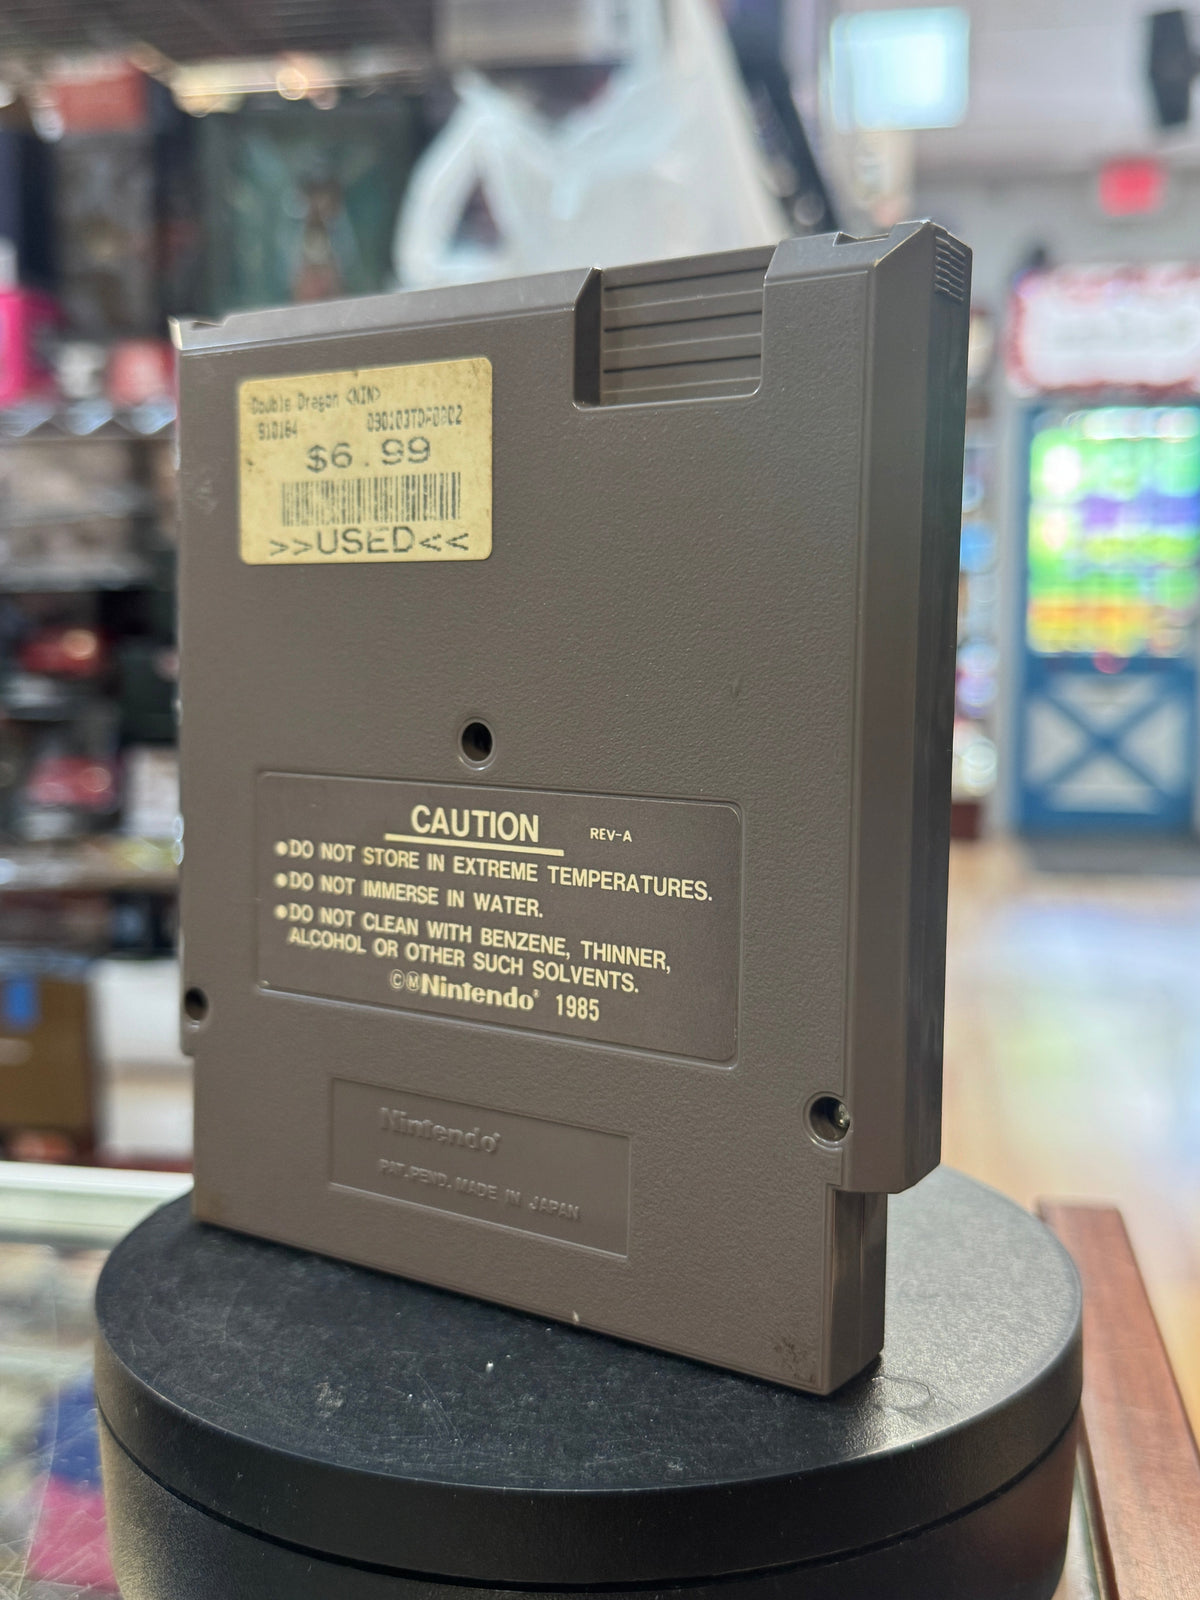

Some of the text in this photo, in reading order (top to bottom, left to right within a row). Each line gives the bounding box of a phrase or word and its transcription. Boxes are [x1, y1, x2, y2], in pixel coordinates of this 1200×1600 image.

[251, 394, 291, 415] Double
[297, 392, 339, 413] Dragon
[306, 436, 431, 473] $6.99
[411, 804, 539, 843] CAUTION
[590, 827, 632, 843] REV-A
[288, 838, 713, 902] DO NOT STORE IN EXTREME TEMPERATURES.
[288, 870, 543, 918] DO NOT IMMERSE IN WATER.
[288, 902, 671, 974] DO NOT CLEAN WITH BENZENE, THINNER,
[288, 927, 639, 994] ALCOHOL OR OTHER SUCH SOLVENTS.
[556, 993, 600, 1022] 1985
[455, 1176, 498, 1201] MADE
[505, 1188, 521, 1205] IN
[529, 1195, 581, 1221] JAPAN
